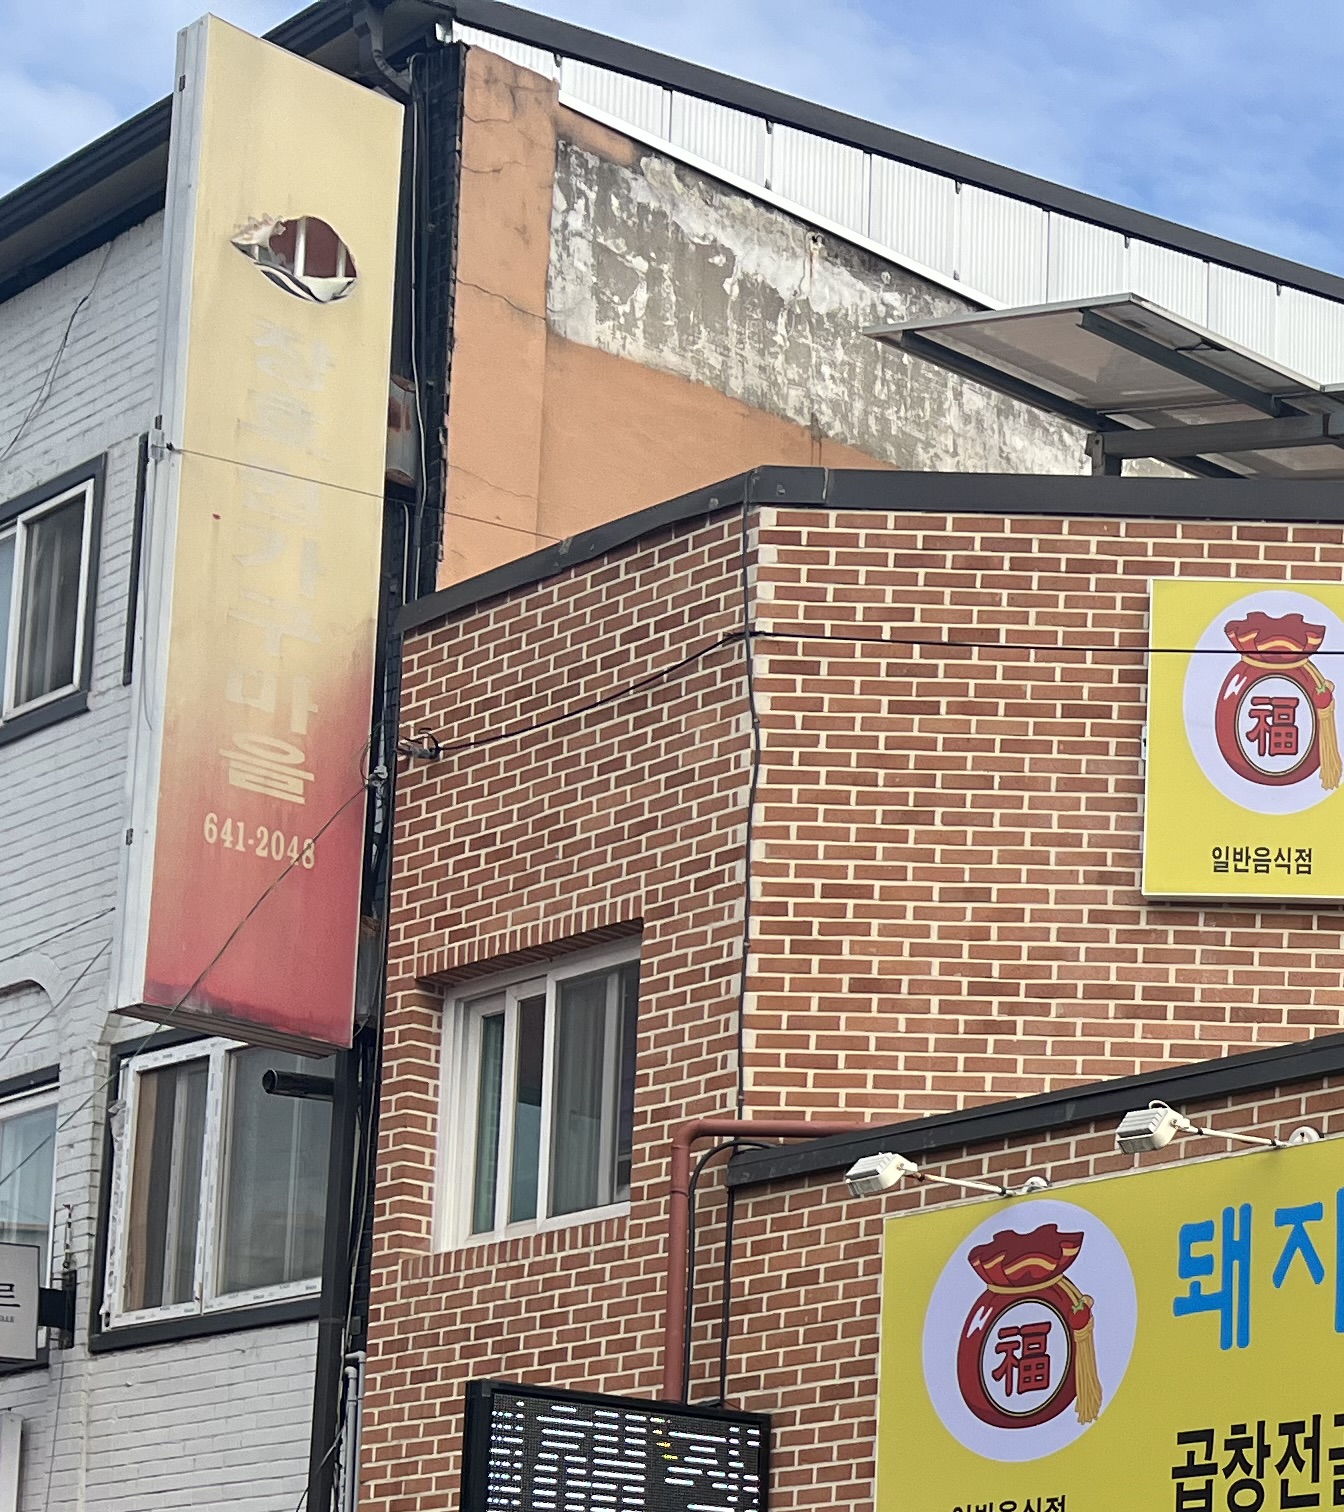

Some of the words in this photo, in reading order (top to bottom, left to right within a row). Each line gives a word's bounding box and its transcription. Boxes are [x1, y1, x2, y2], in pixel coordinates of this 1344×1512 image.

[1245, 695, 1300, 757] 福
[1211, 845, 1314, 876] 일반음식점
[991, 1320, 1052, 1397] 福
